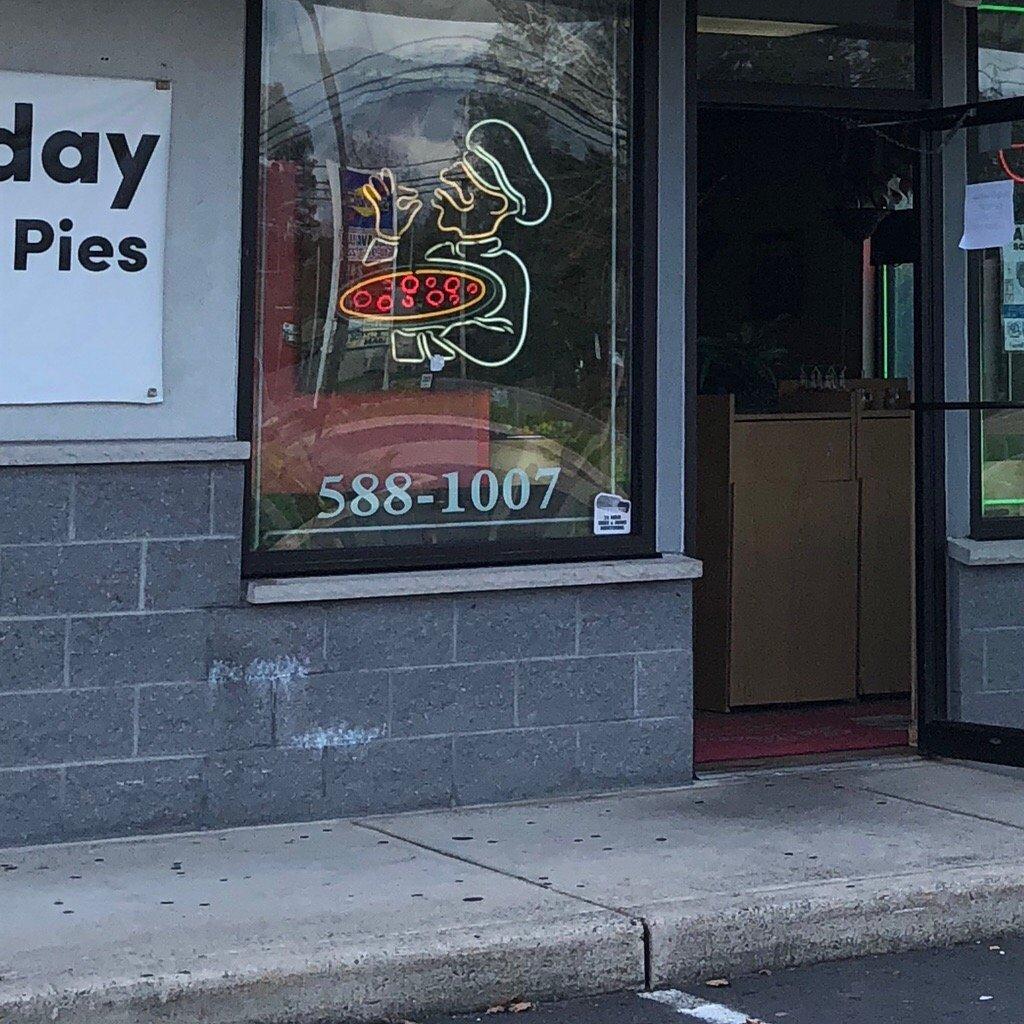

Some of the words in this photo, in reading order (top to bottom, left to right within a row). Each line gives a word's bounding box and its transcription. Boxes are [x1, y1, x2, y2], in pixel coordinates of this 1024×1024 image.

[0, 102, 161, 209] day
[14, 218, 148, 273] Pies
[317, 466, 562, 519] 588-1007
